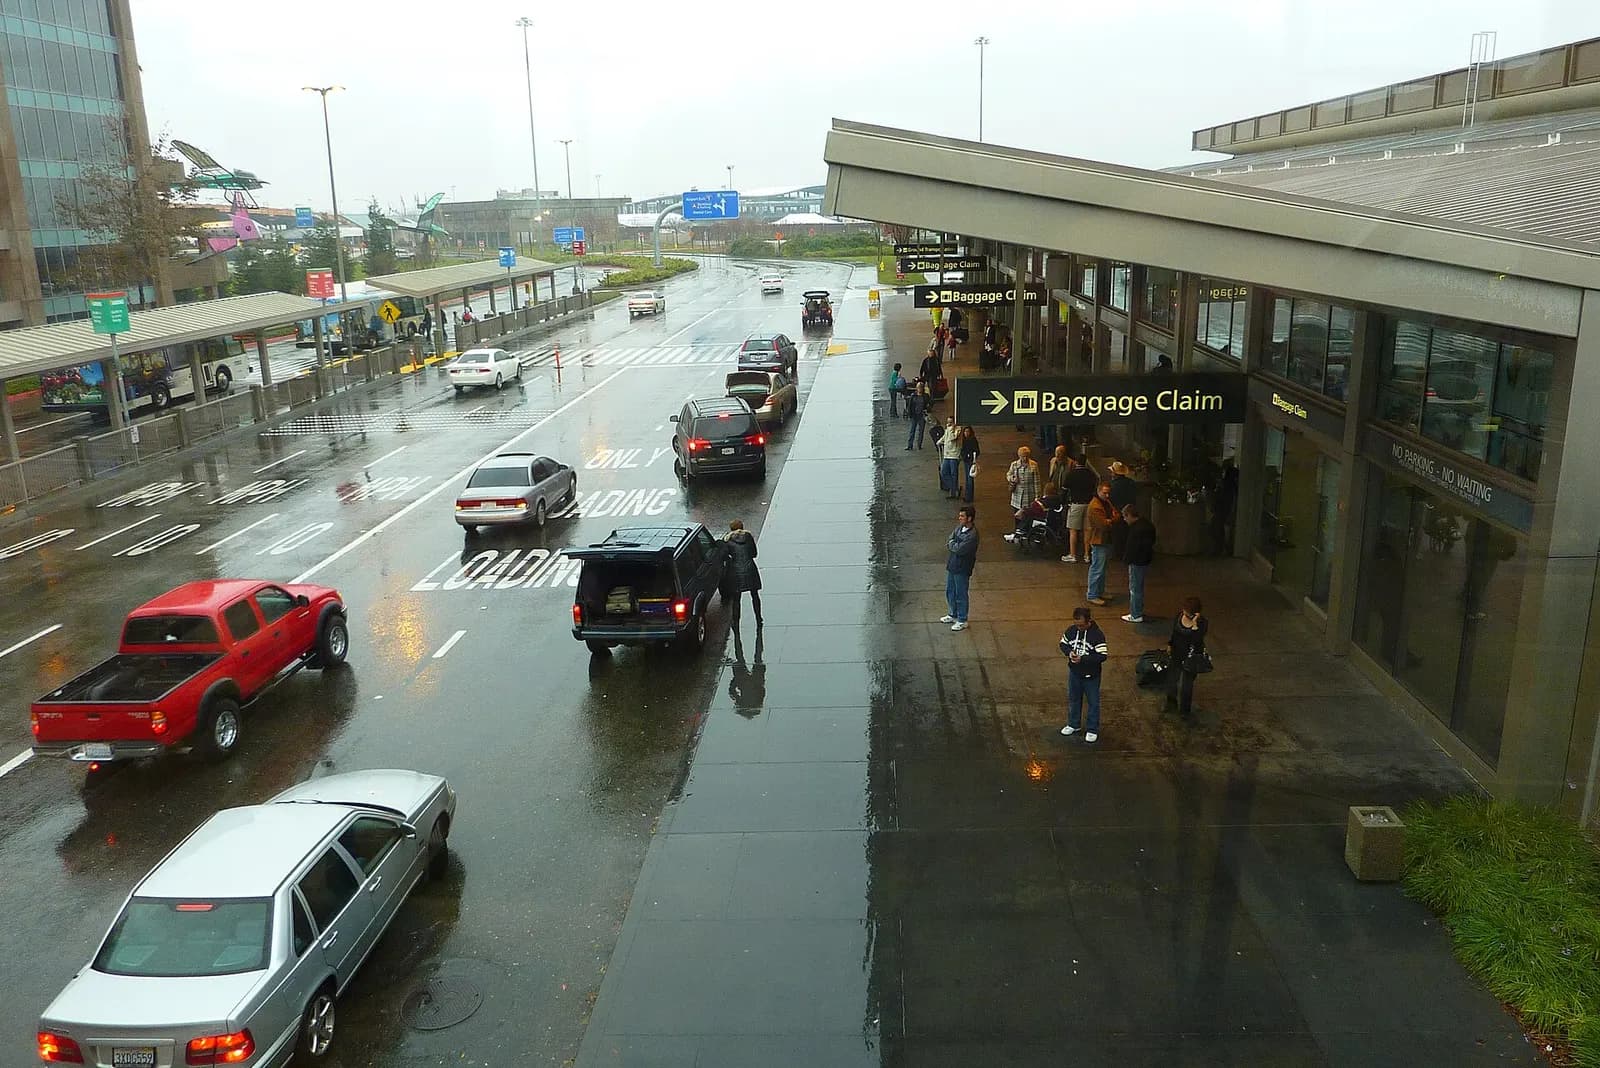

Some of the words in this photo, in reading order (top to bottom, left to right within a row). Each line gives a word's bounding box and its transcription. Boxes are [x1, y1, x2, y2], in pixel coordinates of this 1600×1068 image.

[926, 262, 958, 270] Bagage
[953, 291, 1002, 304] Baggage
[1006, 290, 1036, 300] Clim
[1042, 392, 1148, 417] Baggage
[1156, 389, 1222, 411] Claim
[584, 448, 671, 470] ONLY
[1392, 443, 1402, 459] NO
[1404, 449, 1434, 474] PARKING
[1441, 466, 1454, 484] NO
[1457, 473, 1492, 502] WAITING
[410, 549, 582, 591] LOADIN
